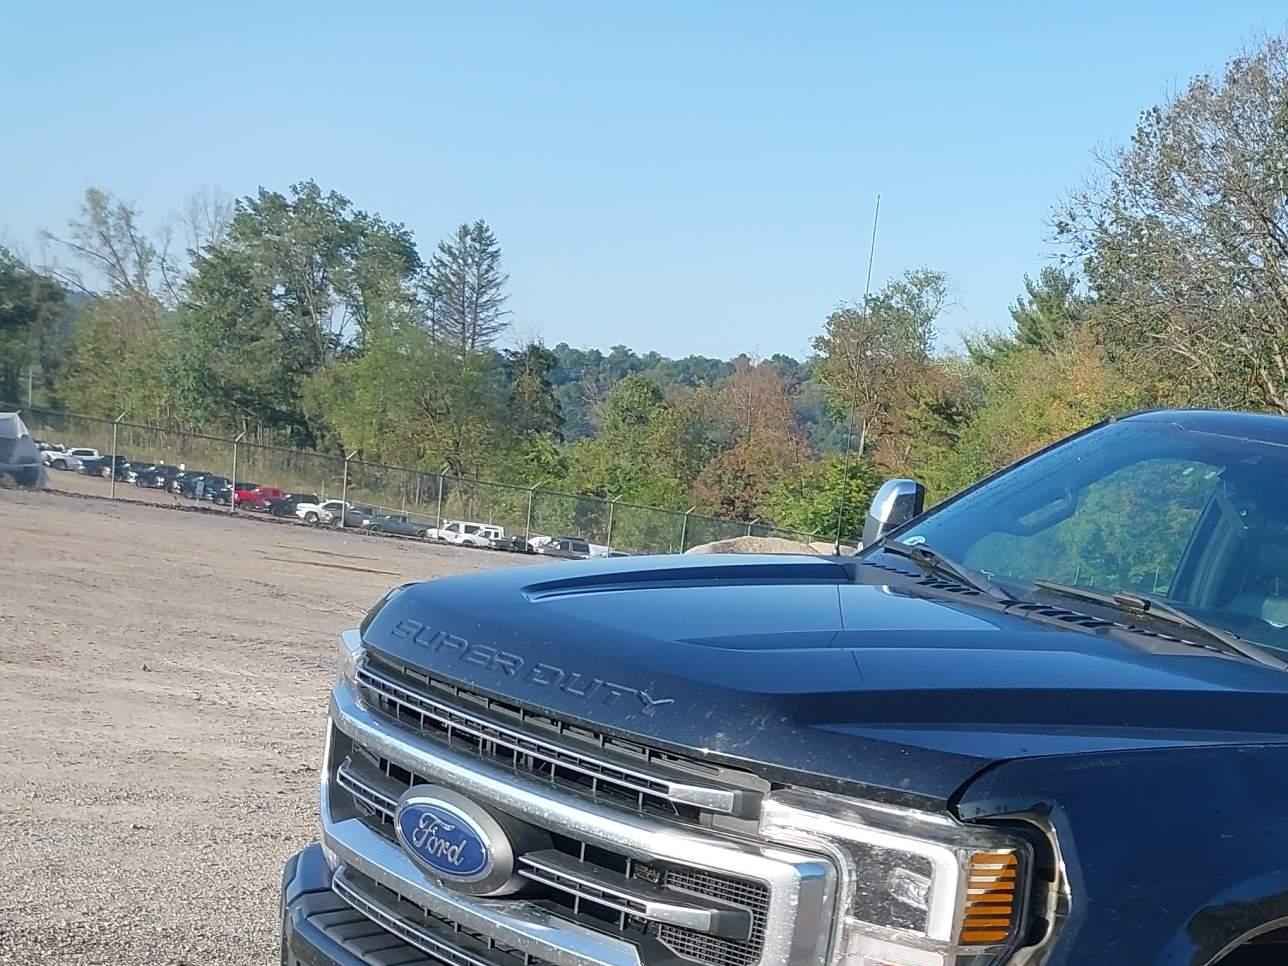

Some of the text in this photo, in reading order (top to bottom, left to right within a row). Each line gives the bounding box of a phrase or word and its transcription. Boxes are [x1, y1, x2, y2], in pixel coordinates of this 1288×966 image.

[390, 619, 676, 717] SUPER DUTY
[412, 812, 468, 866] Ford
